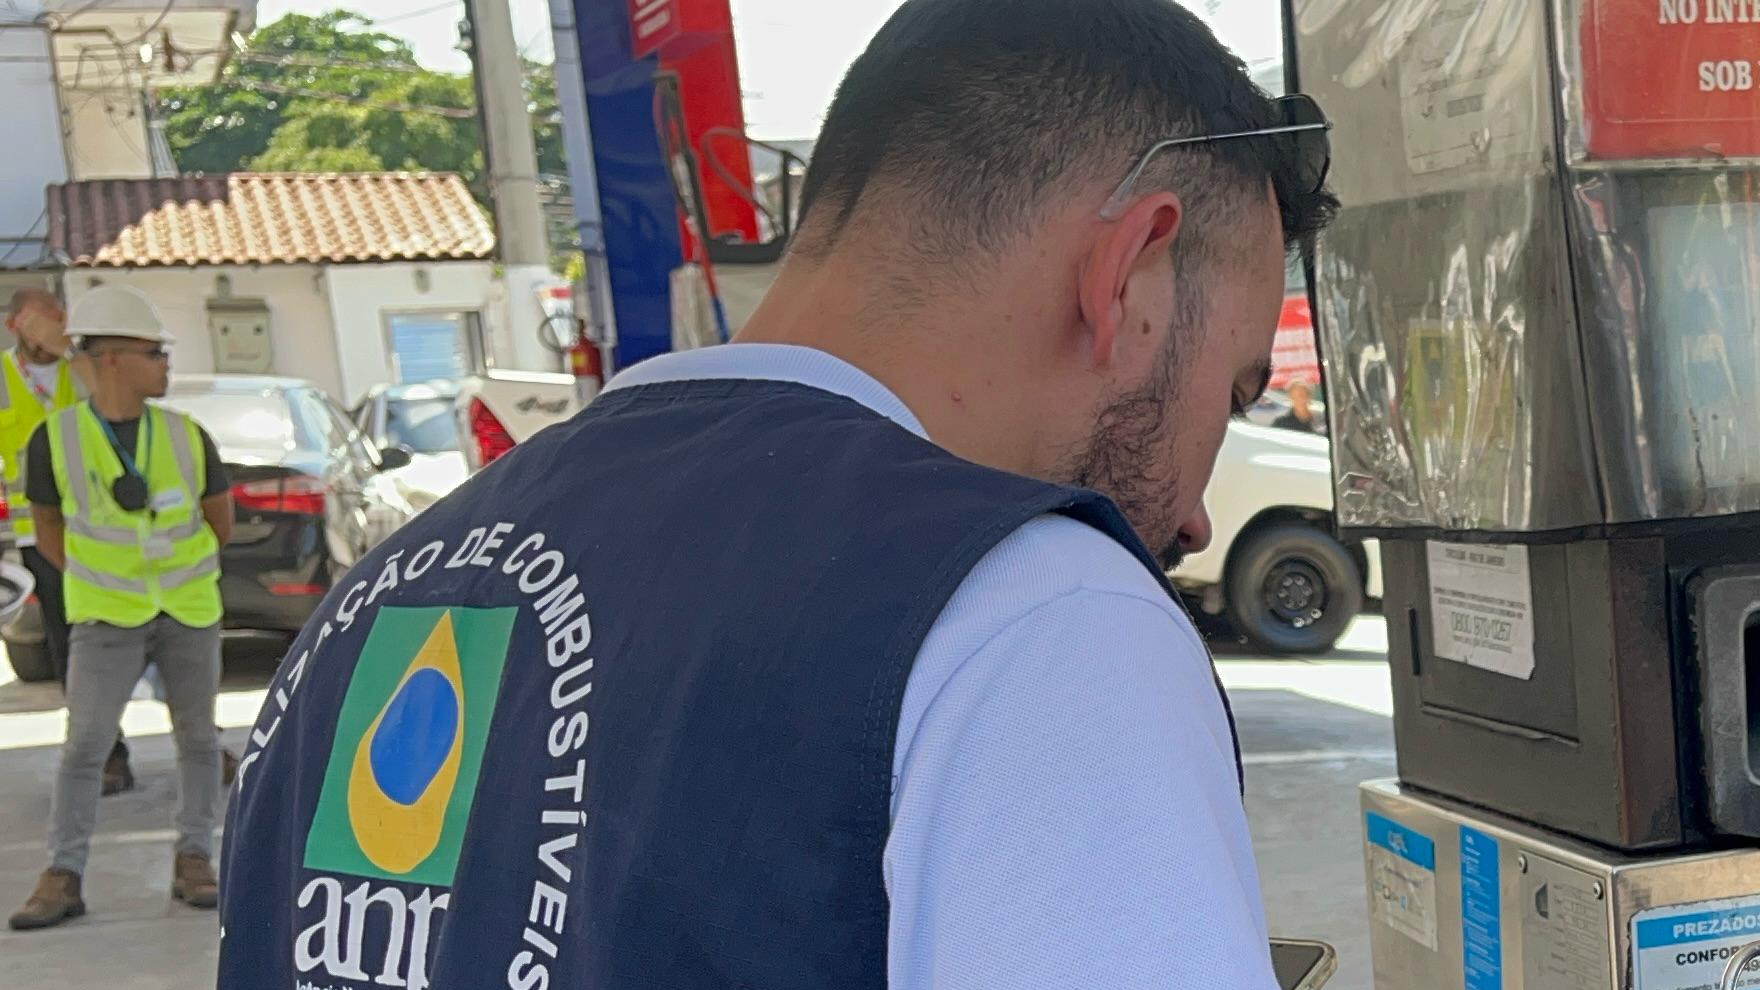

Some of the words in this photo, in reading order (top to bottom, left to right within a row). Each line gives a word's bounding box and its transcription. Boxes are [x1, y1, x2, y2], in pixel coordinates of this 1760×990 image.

[1658, 0, 1697, 24] NO
[1698, 59, 1752, 91] SOB
[445, 521, 515, 569] DE
